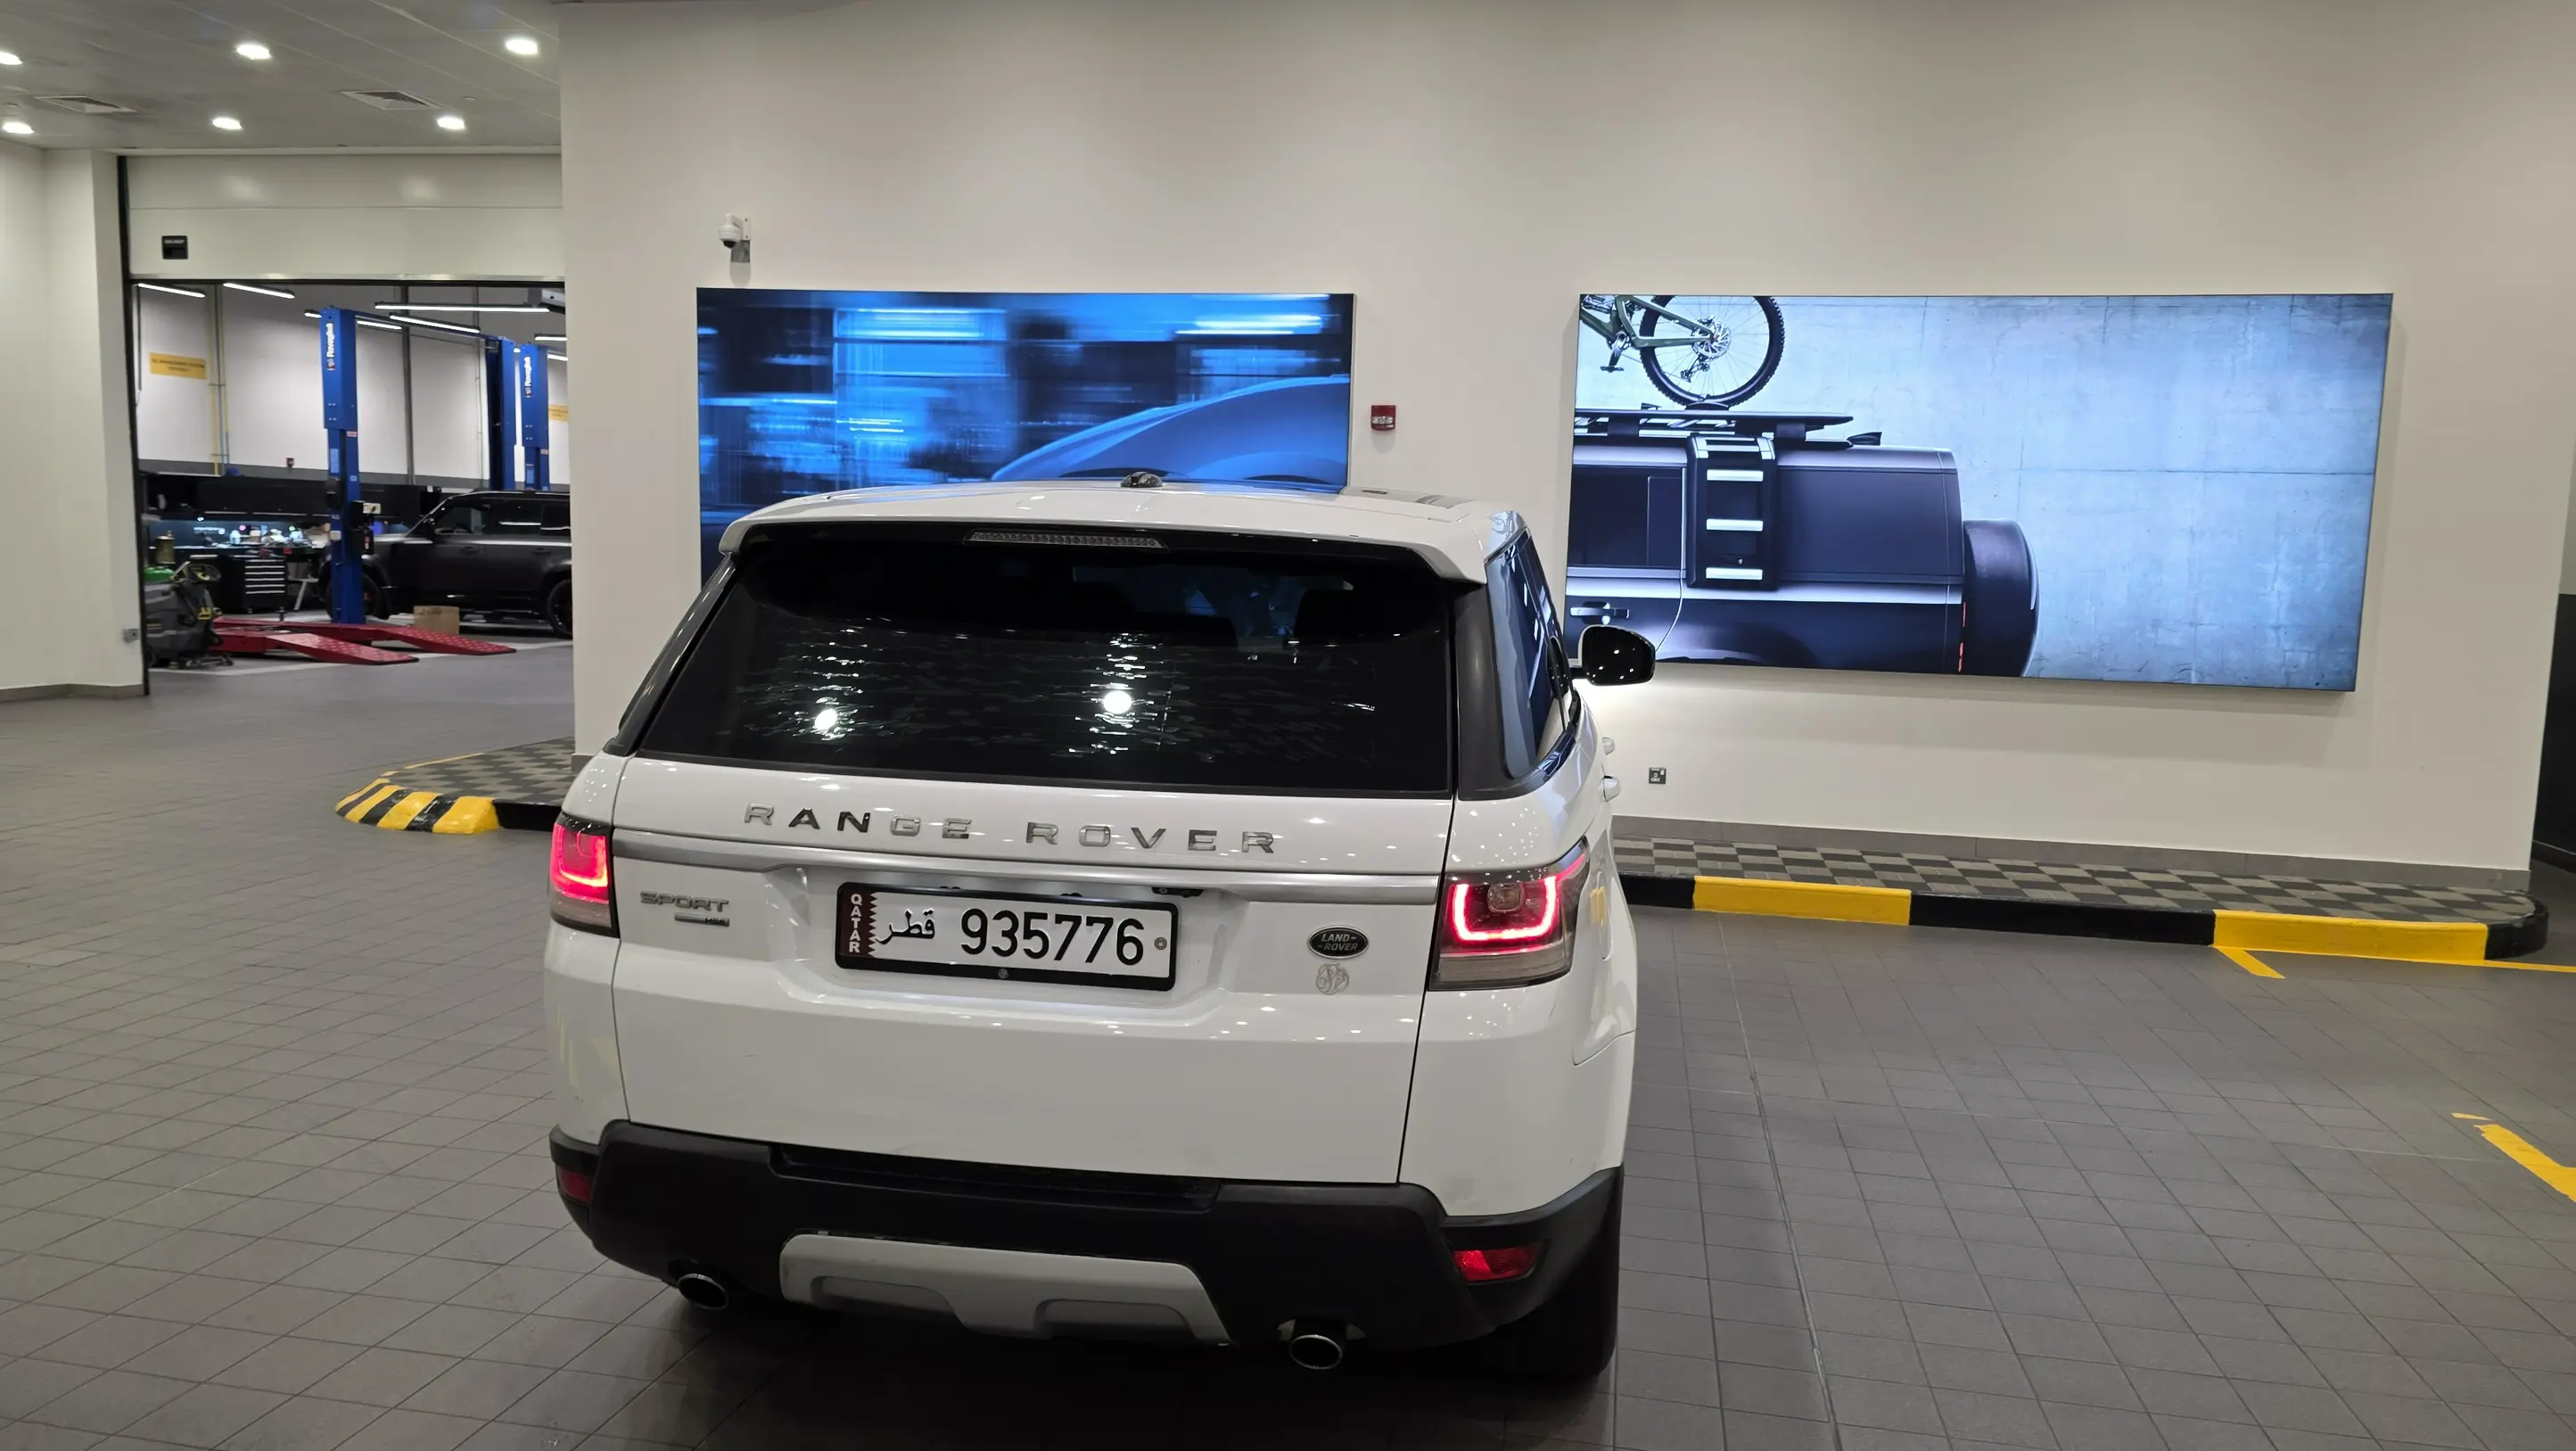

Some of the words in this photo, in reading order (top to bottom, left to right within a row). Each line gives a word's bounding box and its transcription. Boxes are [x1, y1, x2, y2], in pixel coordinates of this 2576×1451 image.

[744, 803, 973, 840] RANGE
[1025, 821, 1275, 853] ROVER
[640, 891, 729, 912] SPORT
[848, 893, 861, 953] QATAR
[875, 907, 935, 944] قطر
[960, 908, 1145, 966] 935776
